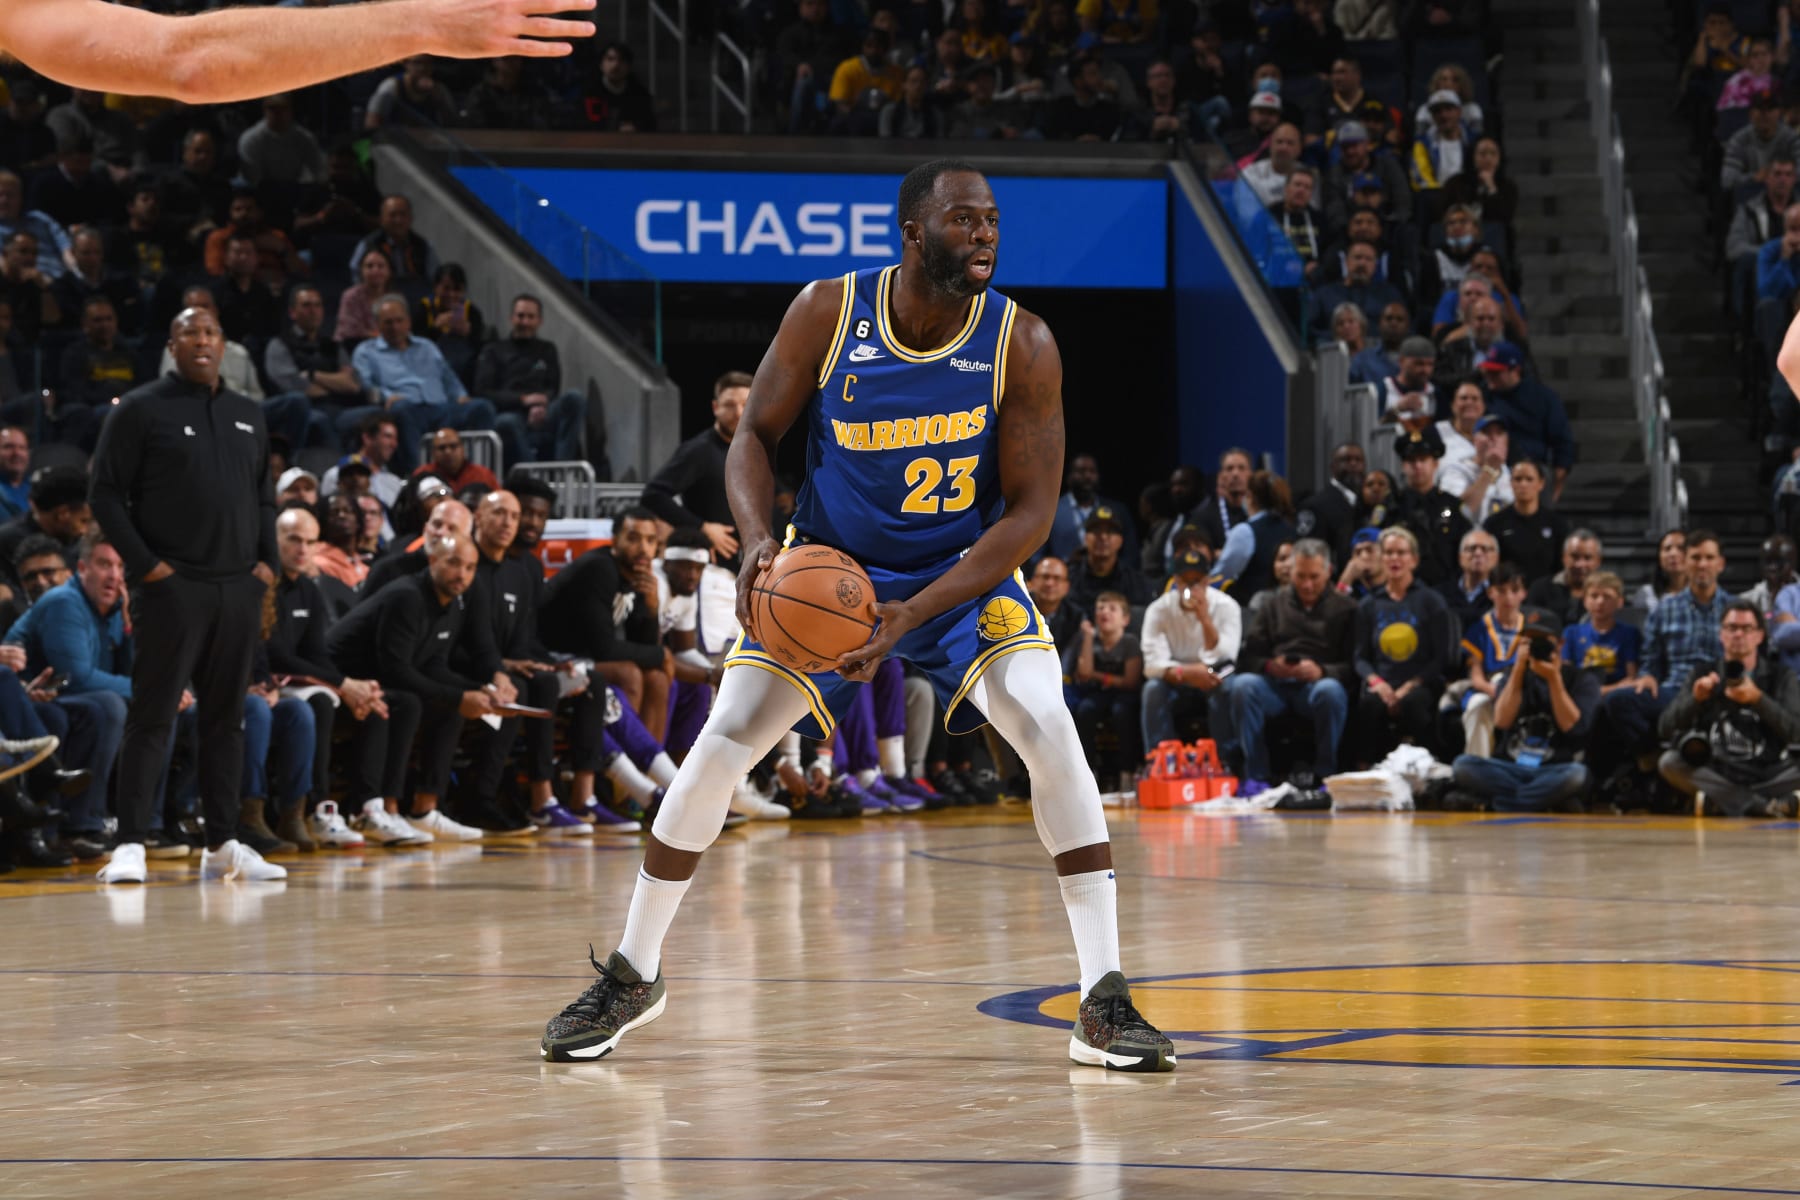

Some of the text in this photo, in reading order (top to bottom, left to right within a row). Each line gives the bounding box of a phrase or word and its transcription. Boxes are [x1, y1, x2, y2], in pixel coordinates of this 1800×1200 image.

[635, 200, 893, 256] CHASE
[856, 321, 870, 338] 6
[950, 357, 992, 373] Rakuten
[843, 374, 858, 402] C
[831, 404, 987, 451] WARRIORS
[901, 455, 979, 513] 23
[1182, 783, 1195, 801] G
